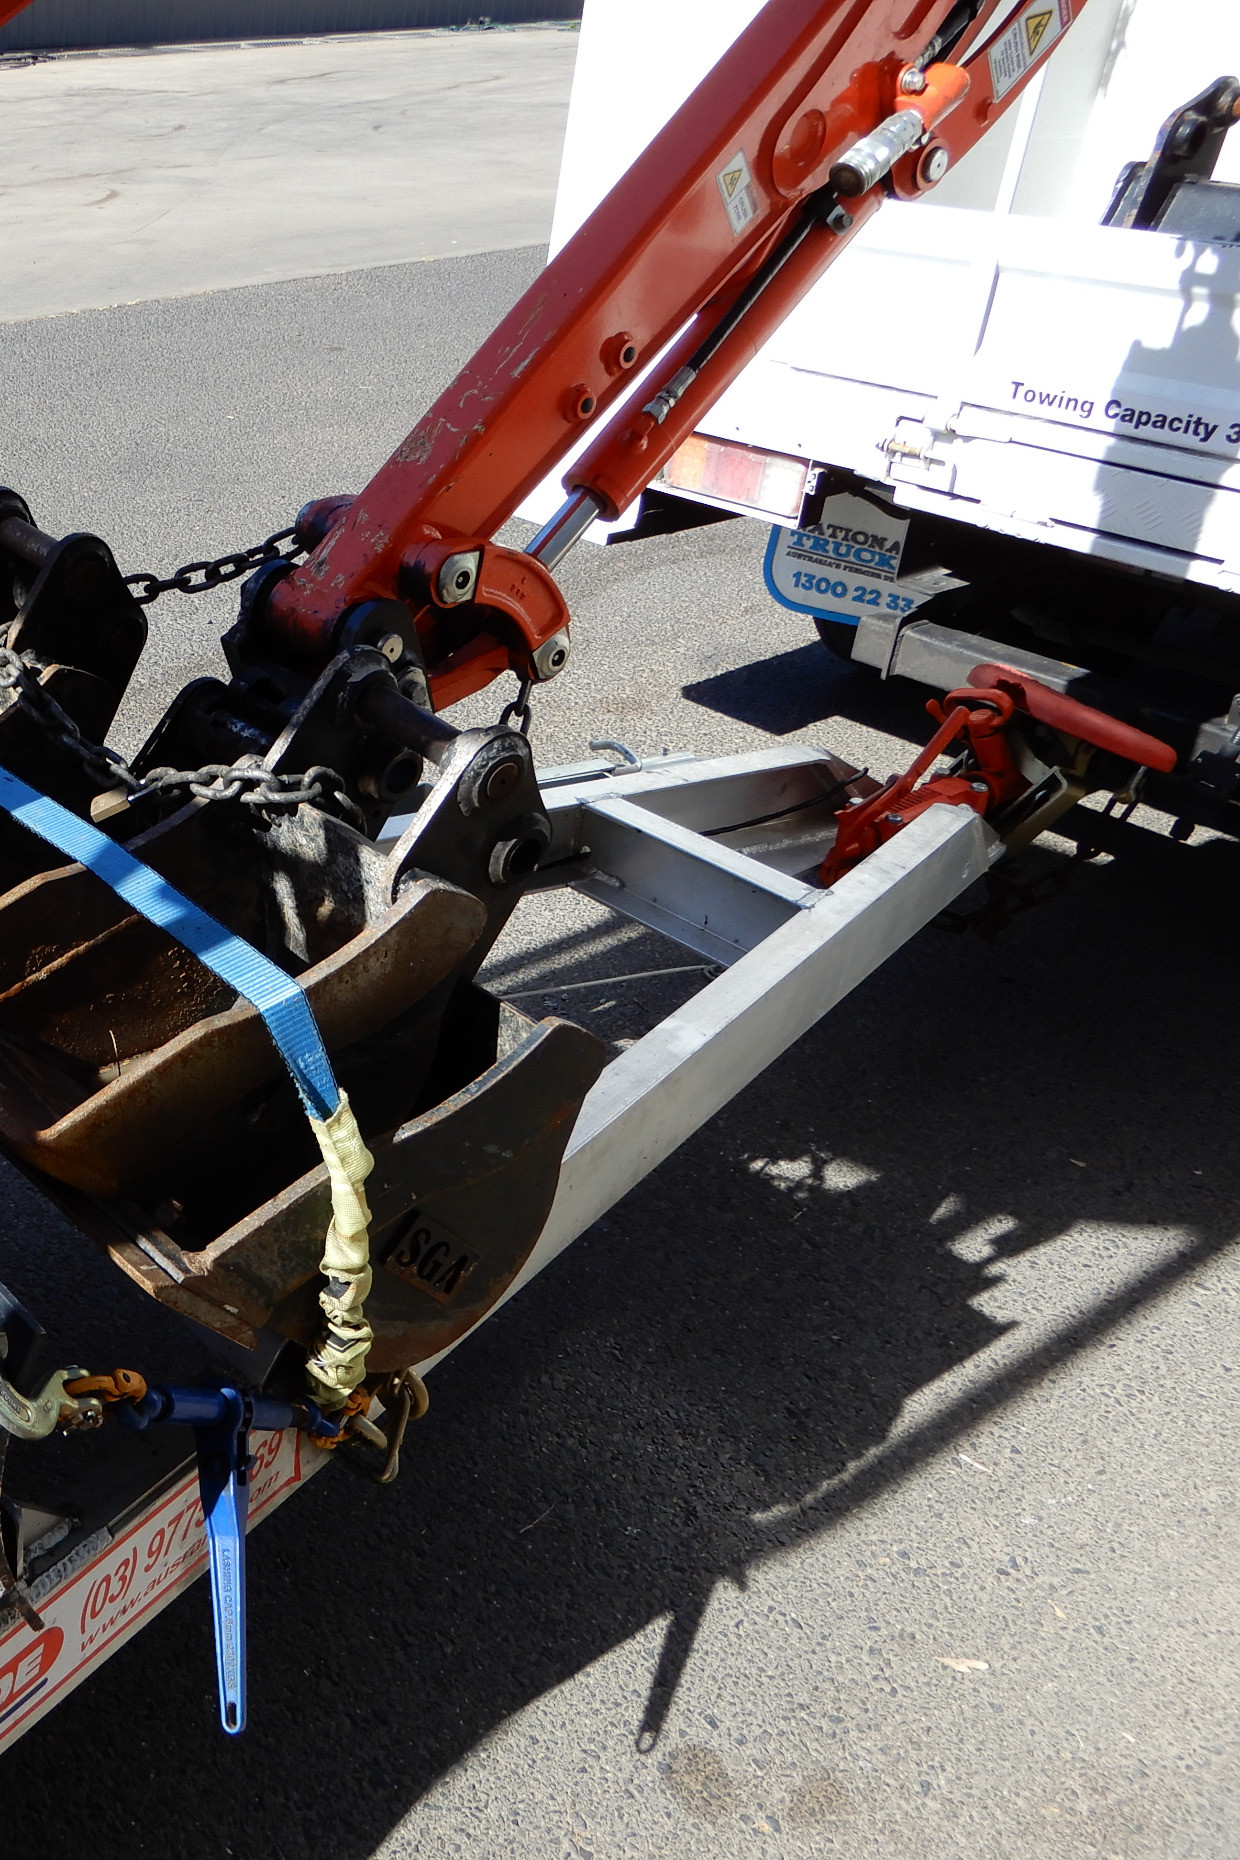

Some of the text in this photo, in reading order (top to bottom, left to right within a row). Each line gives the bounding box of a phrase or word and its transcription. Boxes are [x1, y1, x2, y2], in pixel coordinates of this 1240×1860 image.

[1010, 381, 1095, 419] Towing
[1104, 399, 1219, 443] Capacity
[789, 530, 897, 571] TRUCK
[800, 522, 900, 555] ATIONA
[792, 571, 914, 613] 1300 22 33
[80, 1546, 138, 1635] (03)
